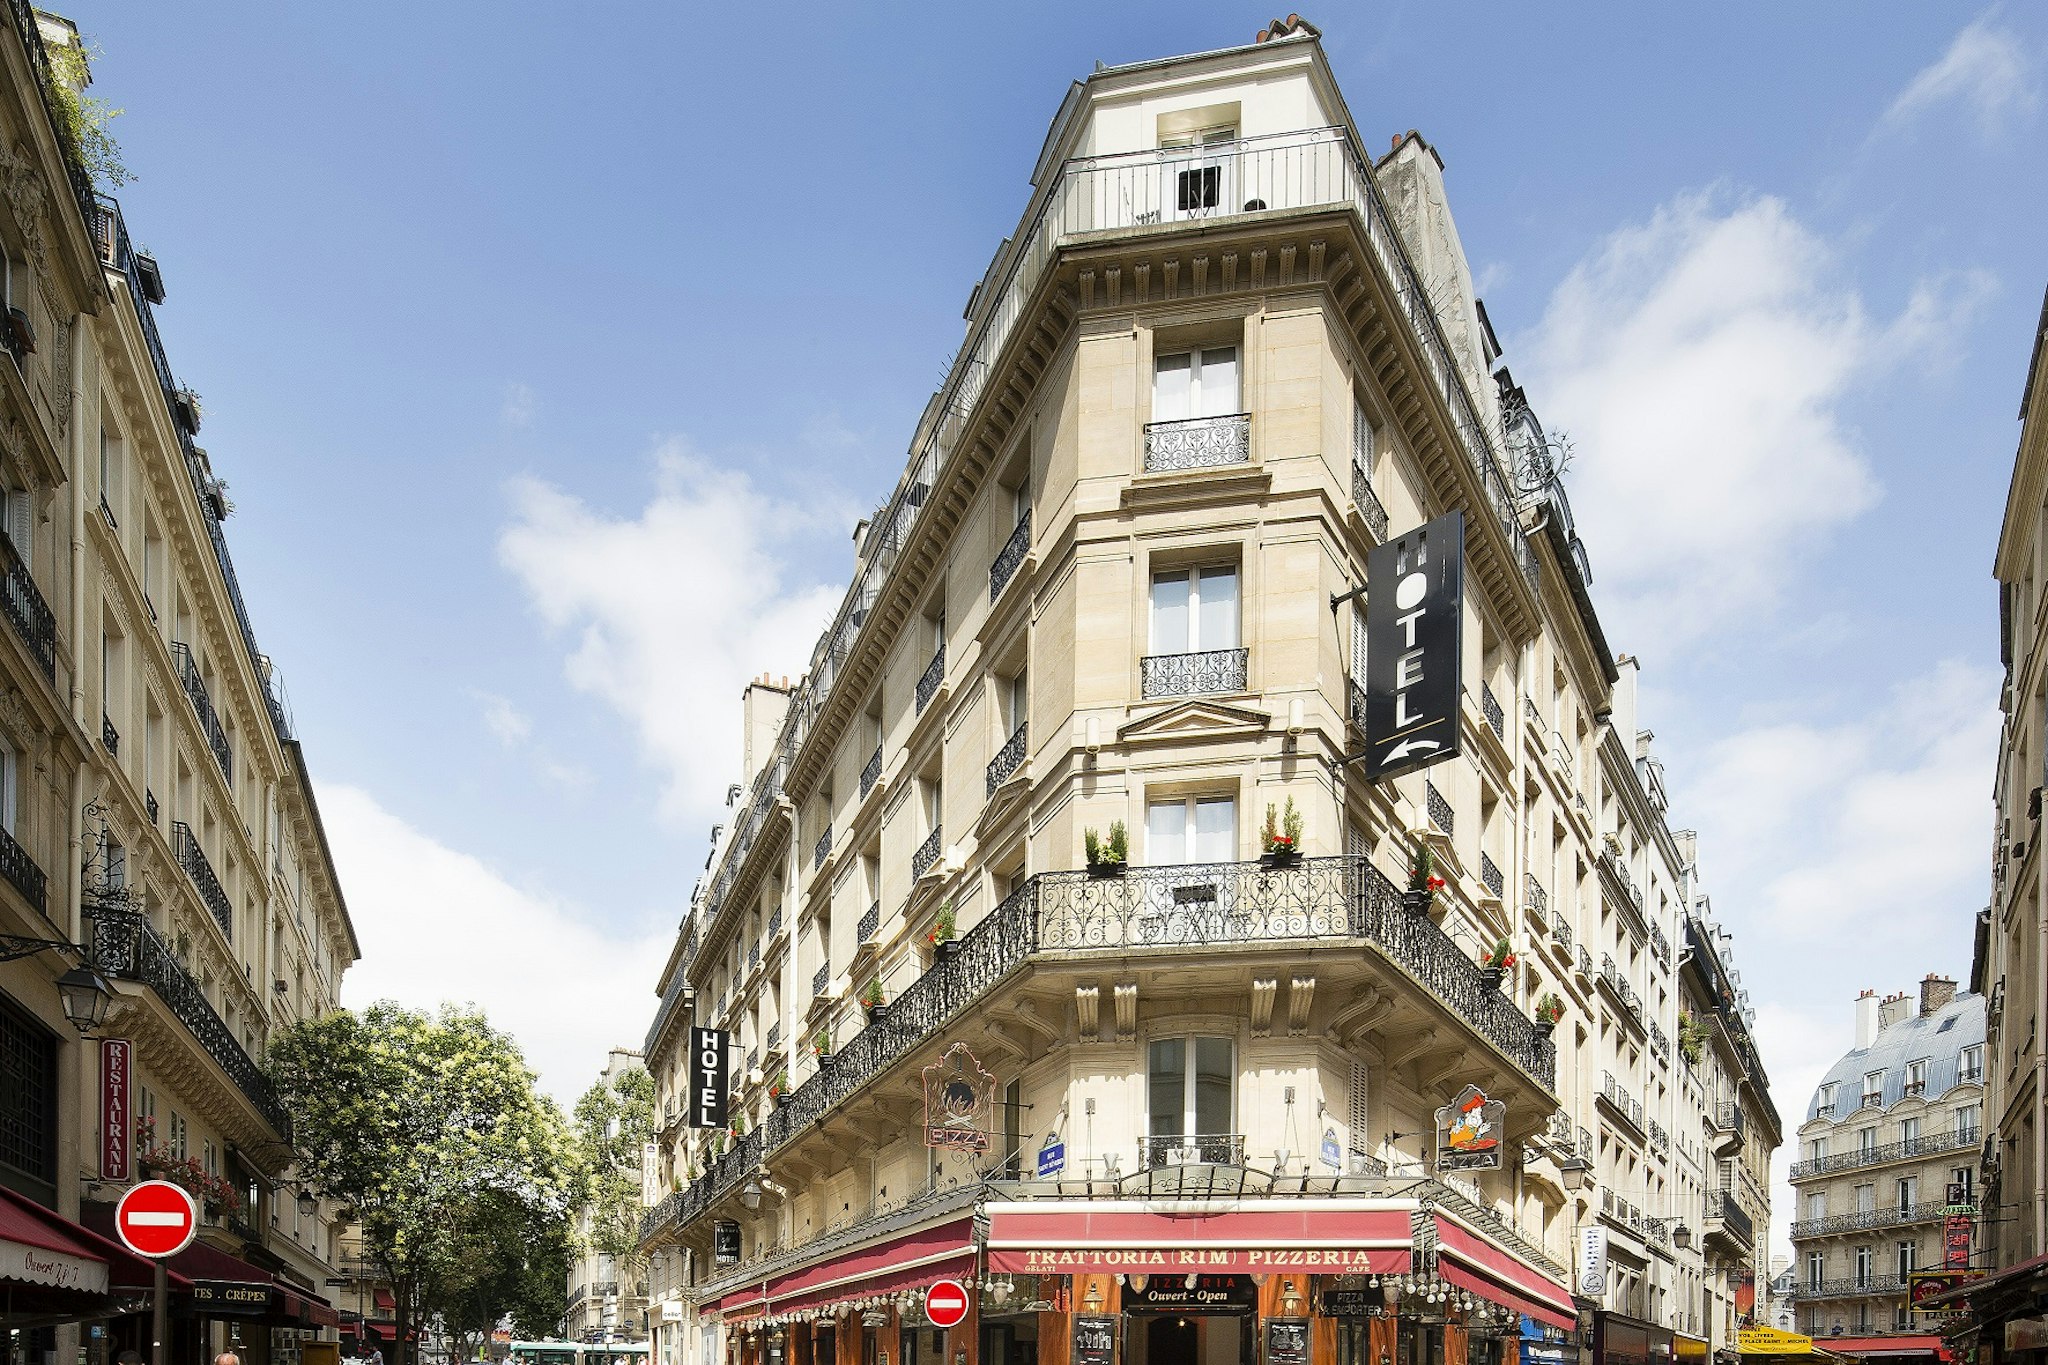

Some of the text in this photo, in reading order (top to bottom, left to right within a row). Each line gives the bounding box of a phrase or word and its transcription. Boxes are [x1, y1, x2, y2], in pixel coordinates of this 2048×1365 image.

[1396, 530, 1427, 729] HOTEL
[701, 1031, 719, 1127] HOTEL
[110, 1043, 122, 1177] RESTAURANT
[646, 1157, 656, 1205] HOTEL
[25, 1251, 54, 1275] Ouvert
[716, 1255, 738, 1263] HOTEL
[1025, 1250, 1165, 1265] TRATTORIA
[1248, 1250, 1370, 1265] PIZZERIA
[1150, 1277, 1236, 1289] IZZRIA
[225, 1287, 266, 1302] CRÊPES
[1148, 1290, 1227, 1303] Ouvert Open
[1337, 1292, 1364, 1304] PIZZA
